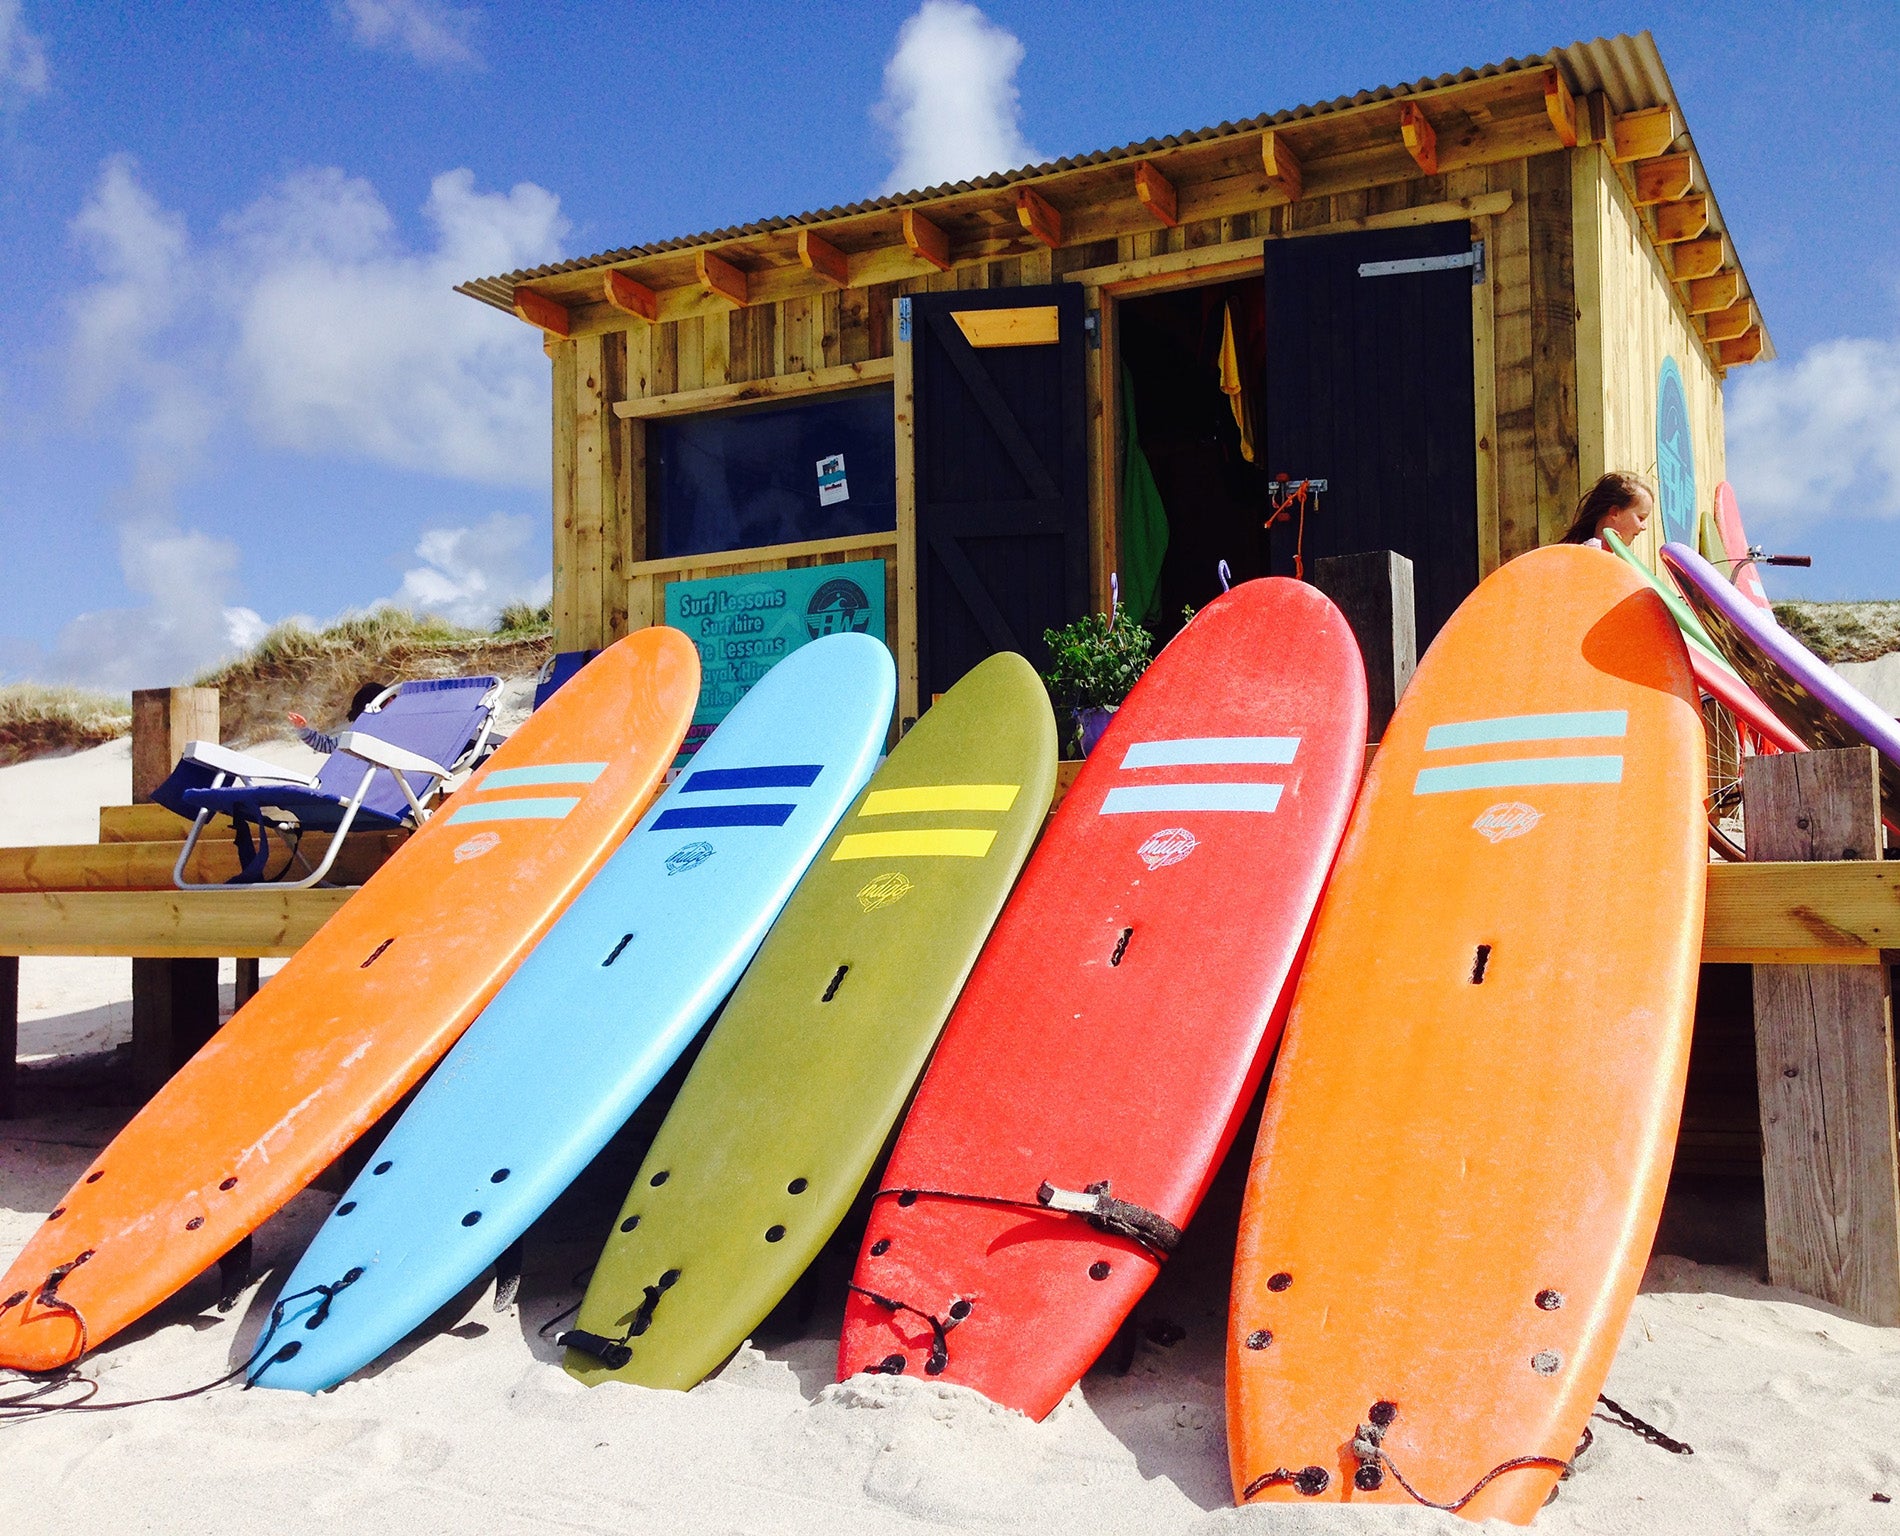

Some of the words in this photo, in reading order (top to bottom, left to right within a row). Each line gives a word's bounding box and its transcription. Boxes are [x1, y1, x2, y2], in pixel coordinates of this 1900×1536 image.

[681, 592, 716, 617] Surf
[720, 591, 785, 613] Lessons
[702, 616, 732, 636] Surf
[734, 615, 763, 632] hire
[720, 638, 784, 658] Lessons
[702, 663, 737, 684] ayak
[701, 688, 731, 708] Bike
